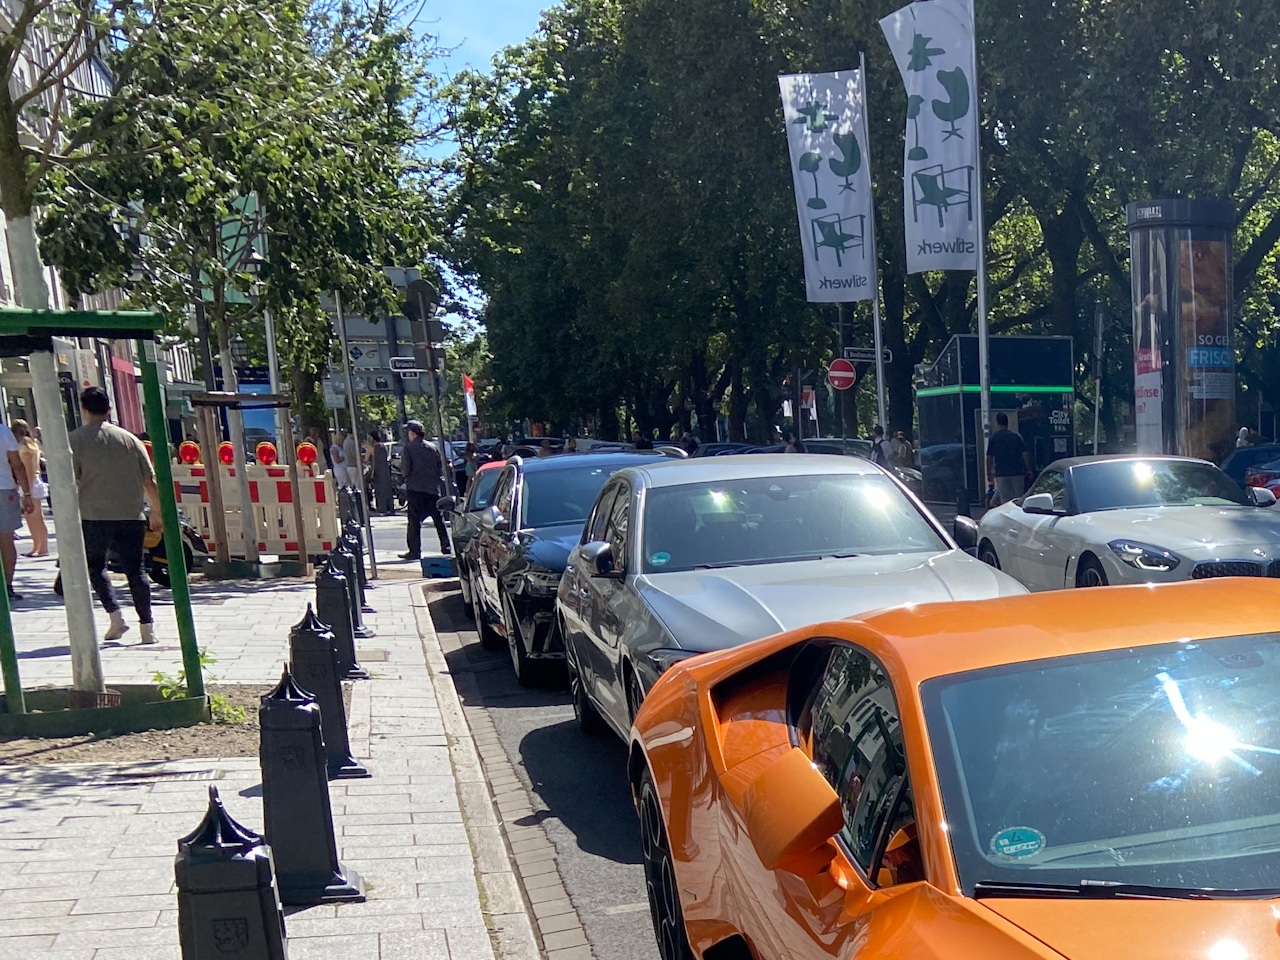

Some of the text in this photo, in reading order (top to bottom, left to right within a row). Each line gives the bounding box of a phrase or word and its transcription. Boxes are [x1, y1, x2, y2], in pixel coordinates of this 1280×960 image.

[1199, 335, 1213, 345] SO
[1052, 410, 1068, 419] City
[1048, 416, 1071, 424] Toilet
